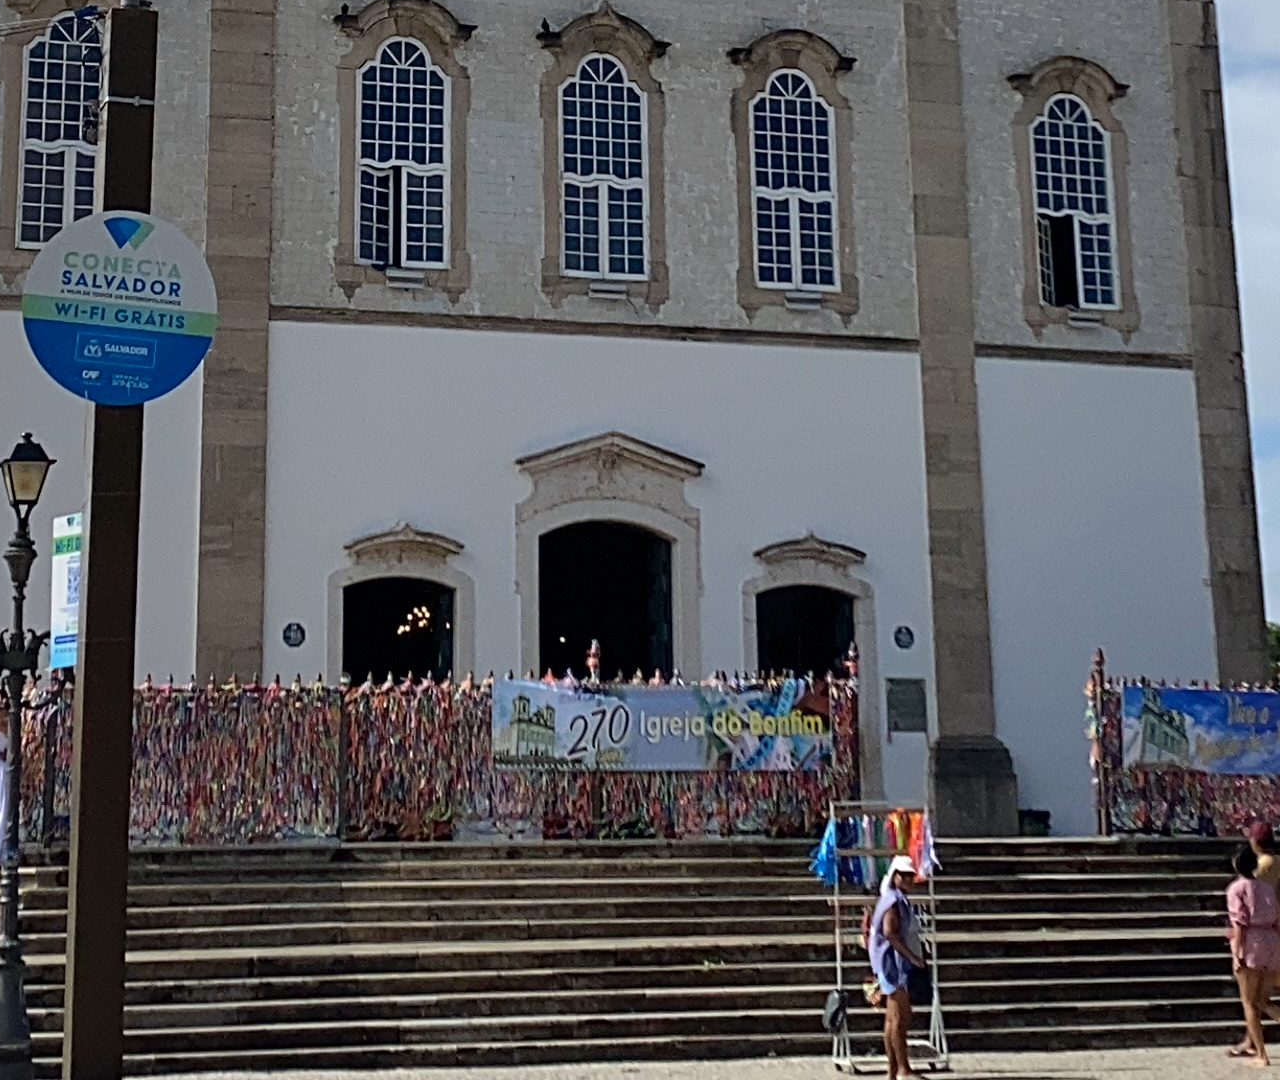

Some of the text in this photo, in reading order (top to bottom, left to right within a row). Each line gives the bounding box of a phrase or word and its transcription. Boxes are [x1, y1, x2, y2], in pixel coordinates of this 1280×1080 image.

[63, 251, 181, 279] CONECTA
[61, 270, 181, 298] SALVADOR
[54, 303, 185, 329] WI-FI GRÁTIS
[104, 343, 149, 356] SALVADOR
[565, 704, 823, 758] 270 Igreja do Bonfim
